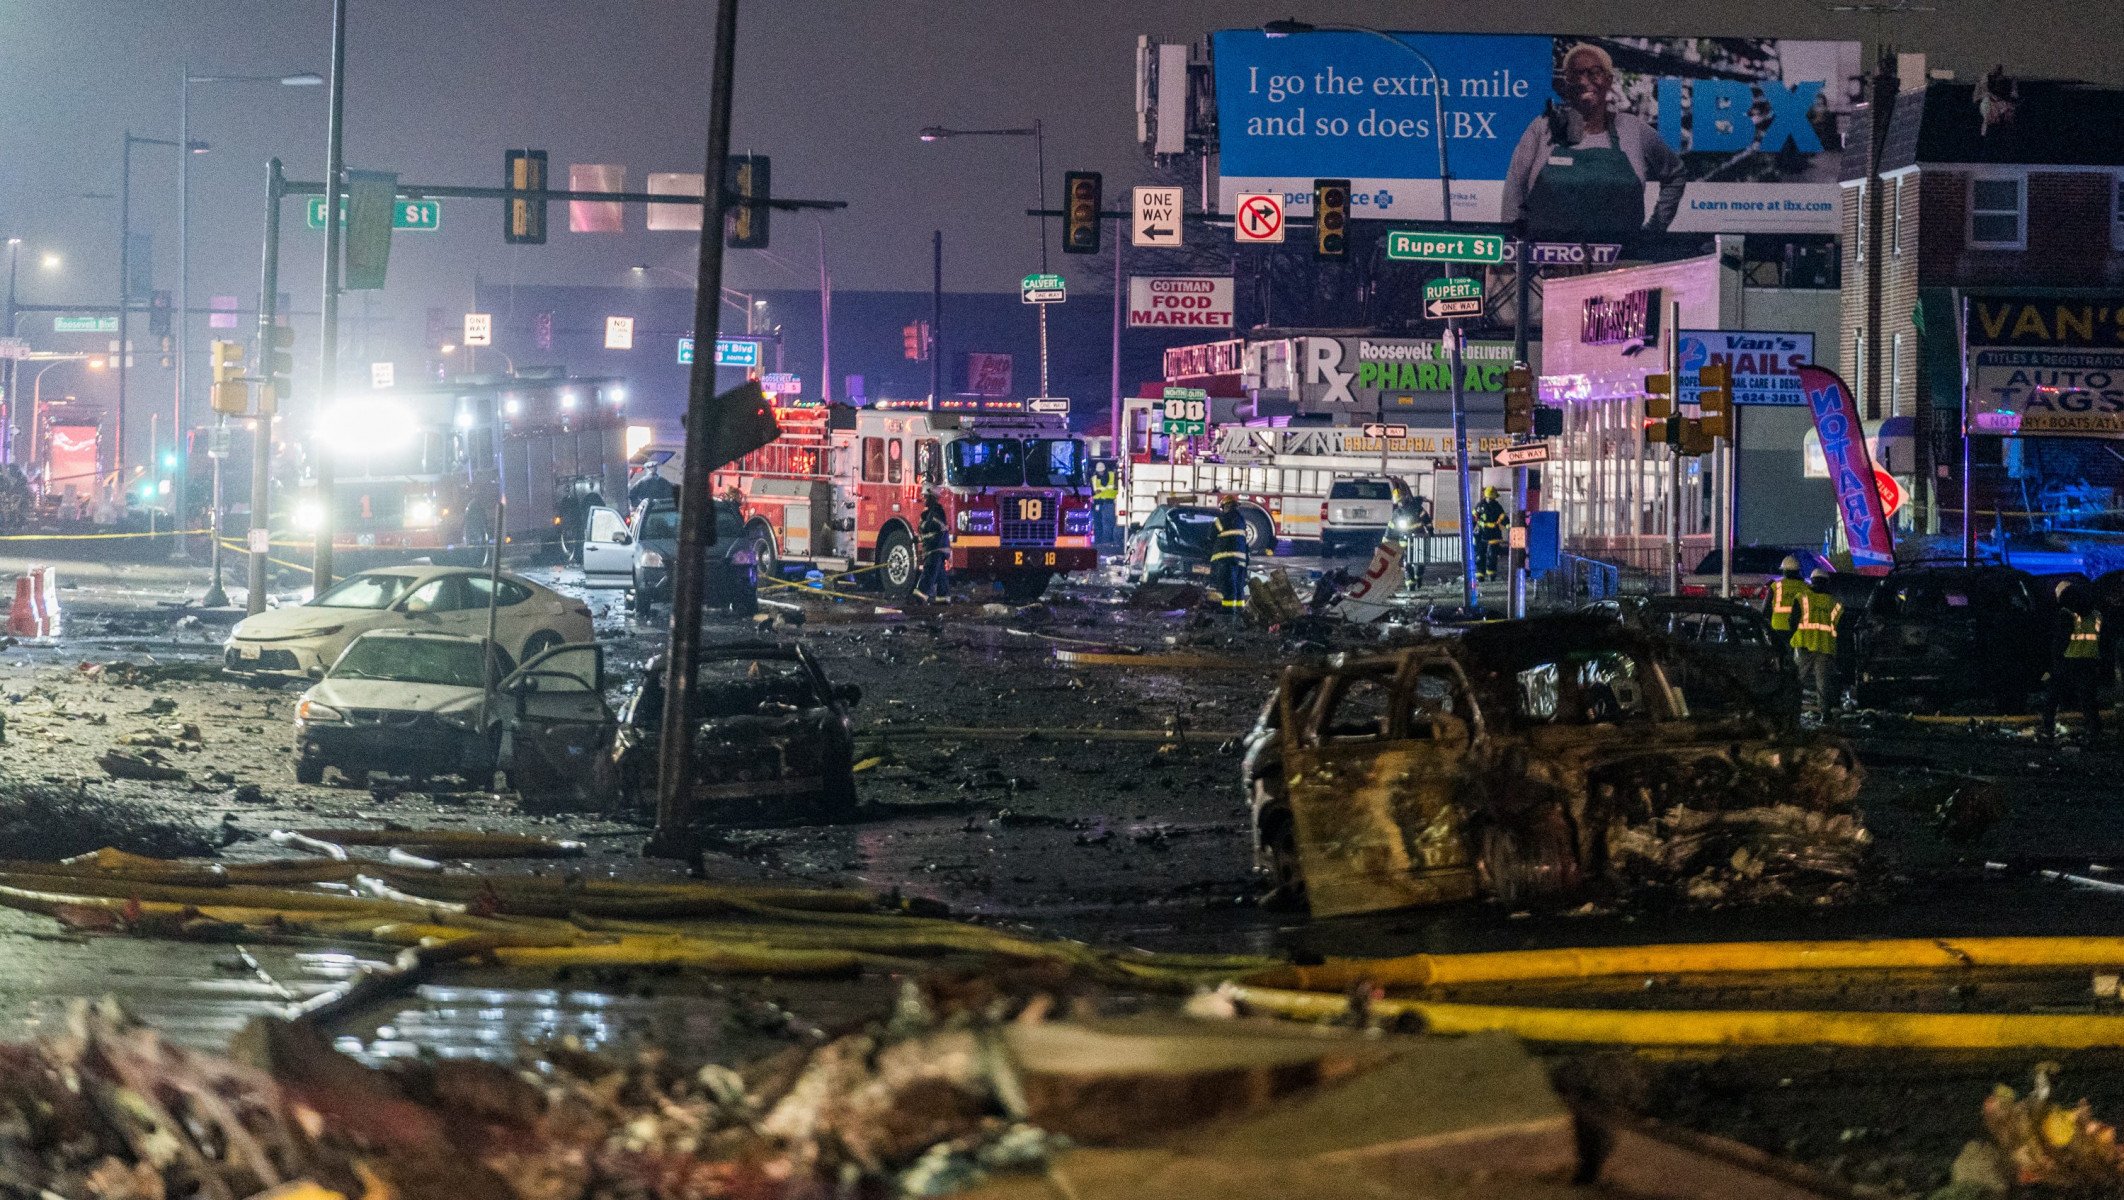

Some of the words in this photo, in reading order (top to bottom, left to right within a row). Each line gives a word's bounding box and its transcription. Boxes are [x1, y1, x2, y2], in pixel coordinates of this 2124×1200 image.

[1248, 67, 1258, 94] I
[1268, 74, 1304, 103] go
[1315, 67, 1364, 95] the
[1373, 72, 1451, 97] extra
[1460, 69, 1529, 98] mile
[1657, 77, 1826, 153] IBX
[1247, 108, 1306, 137] and
[1315, 117, 1349, 137] so
[1358, 109, 1430, 138] does
[1143, 193, 1172, 206] ONE
[1691, 200, 1727, 210] Learn
[1731, 201, 1764, 210] more
[1767, 200, 1780, 210] at
[1784, 200, 1832, 211] ibx.com
[405, 205, 429, 223] St
[1143, 209, 1173, 221] WAY
[1397, 237, 1464, 256] Rupert
[1473, 239, 1494, 256] St
[1023, 279, 1057, 289] CALVERT
[1153, 280, 1211, 292] COTTMAN
[1427, 284, 1470, 298] RUPERT
[1472, 287, 1480, 295] ST
[1152, 295, 1212, 308] FOOD
[1442, 303, 1458, 311] ONE
[1132, 311, 1232, 325] MARKET
[682, 342, 729, 353] Roelt
[731, 343, 753, 354] Blvd
[1359, 340, 1433, 360] Roosevelt
[1467, 345, 1515, 360] DELIVERY
[1726, 335, 1797, 351] Van's
[1710, 353, 1806, 375] NAILS
[1988, 352, 2027, 364] TITLES
[2031, 353, 2039, 364] &
[2042, 354, 2124, 367] REGISTRATIO
[1307, 337, 1355, 402] Rx
[1359, 362, 1511, 391] PHARMAC
[1749, 378, 1768, 389] CARE
[2007, 370, 2112, 389] AUTO
[1166, 389, 1185, 397] NORTH
[1189, 390, 1204, 398] OUTH
[1991, 388, 2124, 413] TAGS
[1171, 403, 1177, 416] 1
[1191, 404, 1197, 417] 1
[1442, 437, 1472, 452] FIE
[1508, 451, 1525, 460] ONE
[1527, 449, 1544, 458] WAY
[1875, 477, 1896, 501] ENTE
[361, 494, 373, 518] 1
[1018, 498, 1042, 520] 18
[1014, 552, 1023, 565] E
[1045, 552, 1056, 565] 18
